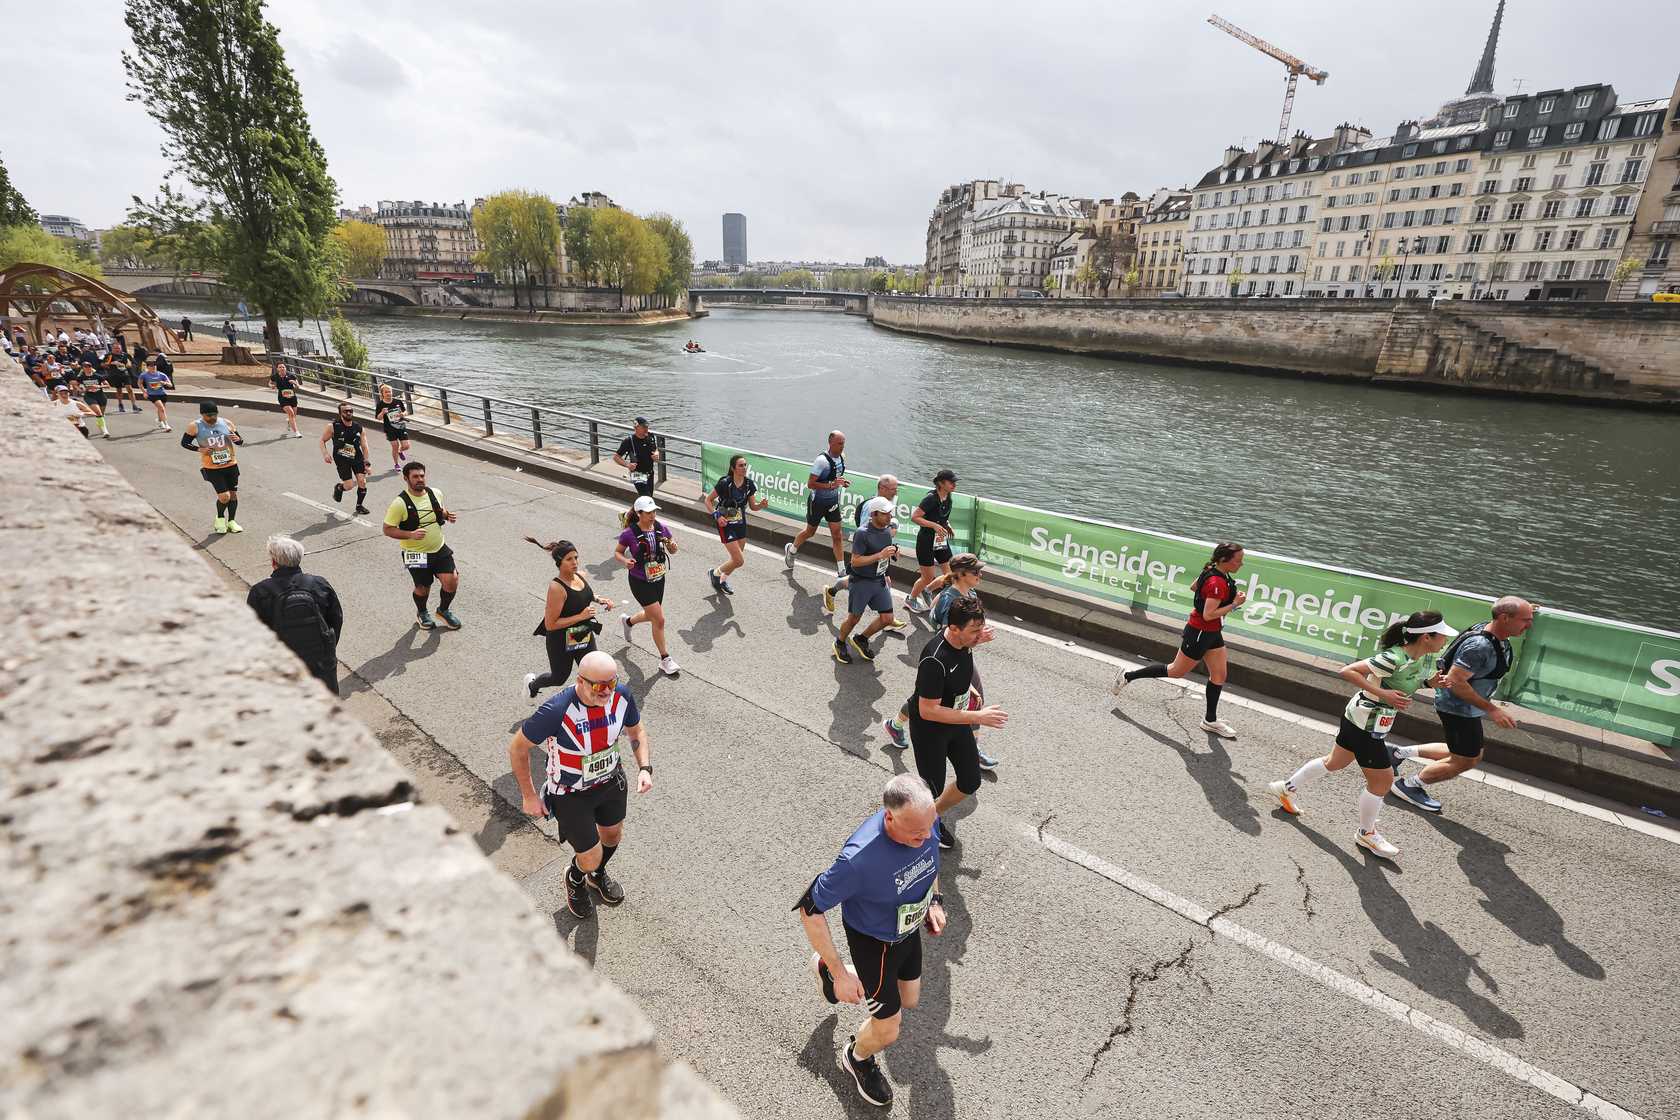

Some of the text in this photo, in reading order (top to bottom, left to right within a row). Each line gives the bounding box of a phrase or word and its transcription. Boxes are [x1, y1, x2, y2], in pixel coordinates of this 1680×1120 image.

[1030, 527, 1186, 583] Schneider
[1089, 566, 1177, 601] Electric
[1279, 612, 1380, 651] Electri
[588, 755, 613, 773] 49014
